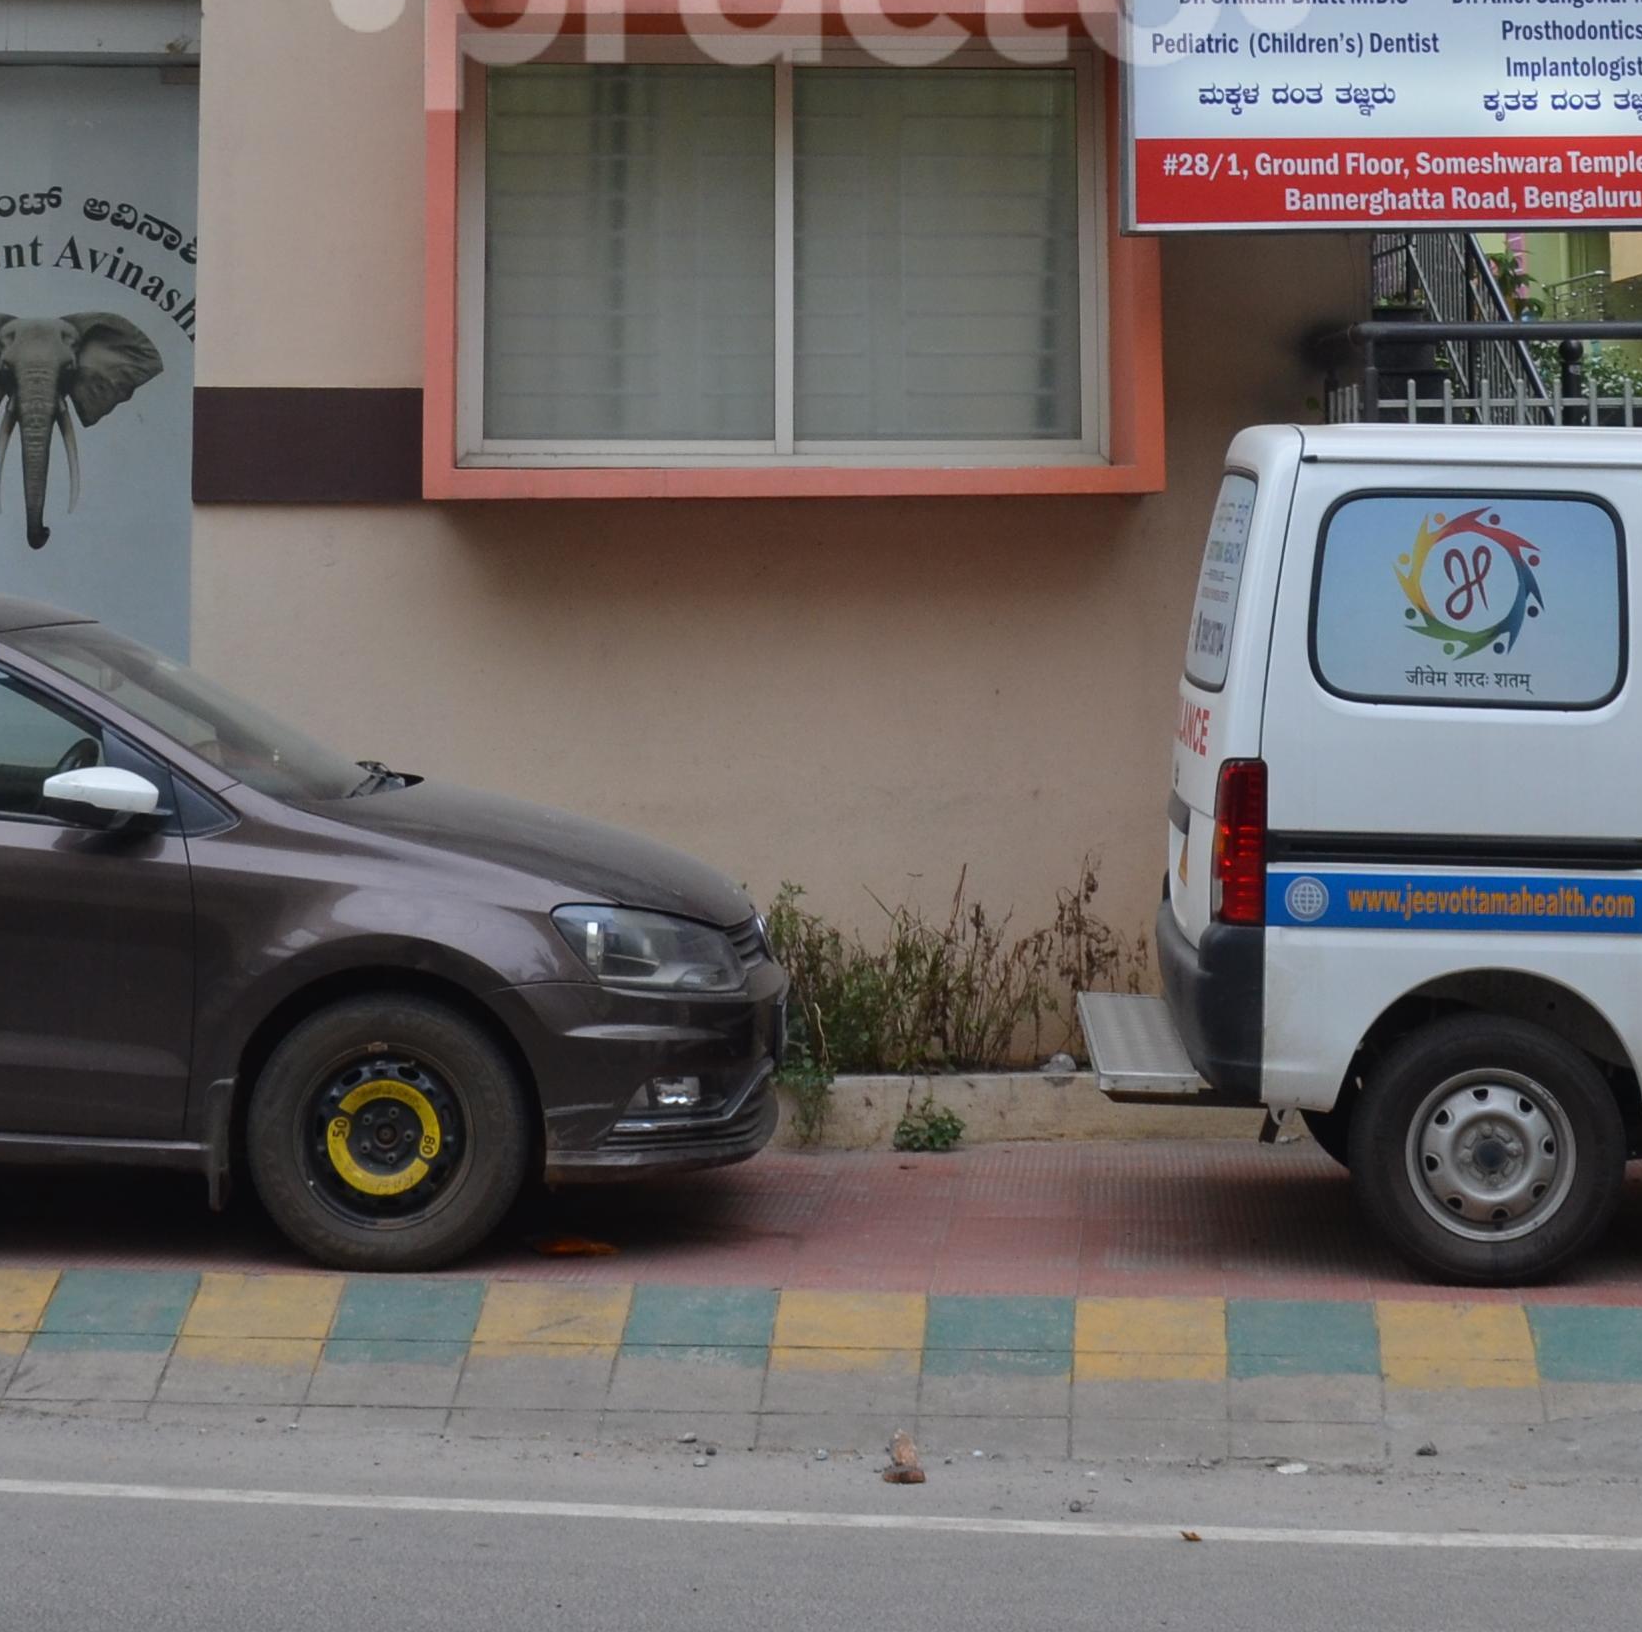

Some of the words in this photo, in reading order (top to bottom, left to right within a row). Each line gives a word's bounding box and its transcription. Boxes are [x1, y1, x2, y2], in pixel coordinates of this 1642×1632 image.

[1152, 33, 1238, 54] Pediatric
[1370, 33, 1439, 54] Dentist
[1199, 82, 1259, 115] ಮಕ್ಕಳ
[1272, 83, 1323, 104] ದಂತ
[1335, 84, 1396, 117] ತಜ್ಞರು
[1163, 153, 1248, 180] #28/1,
[1256, 154, 1340, 176] Ground
[1346, 153, 1409, 179] Floor,
[1416, 152, 1562, 175] Someshwara
[1285, 189, 1445, 215] Bannerghatta
[1451, 188, 1517, 213] Road,
[1524, 187, 1642, 213] Bengaluru
[1405, 665, 1447, 687] जीवेम
[1455, 671, 1490, 687] शरदः
[1494, 673, 1532, 694] शतम्
[1348, 883, 1635, 920] www.jeevottamahealth.com
